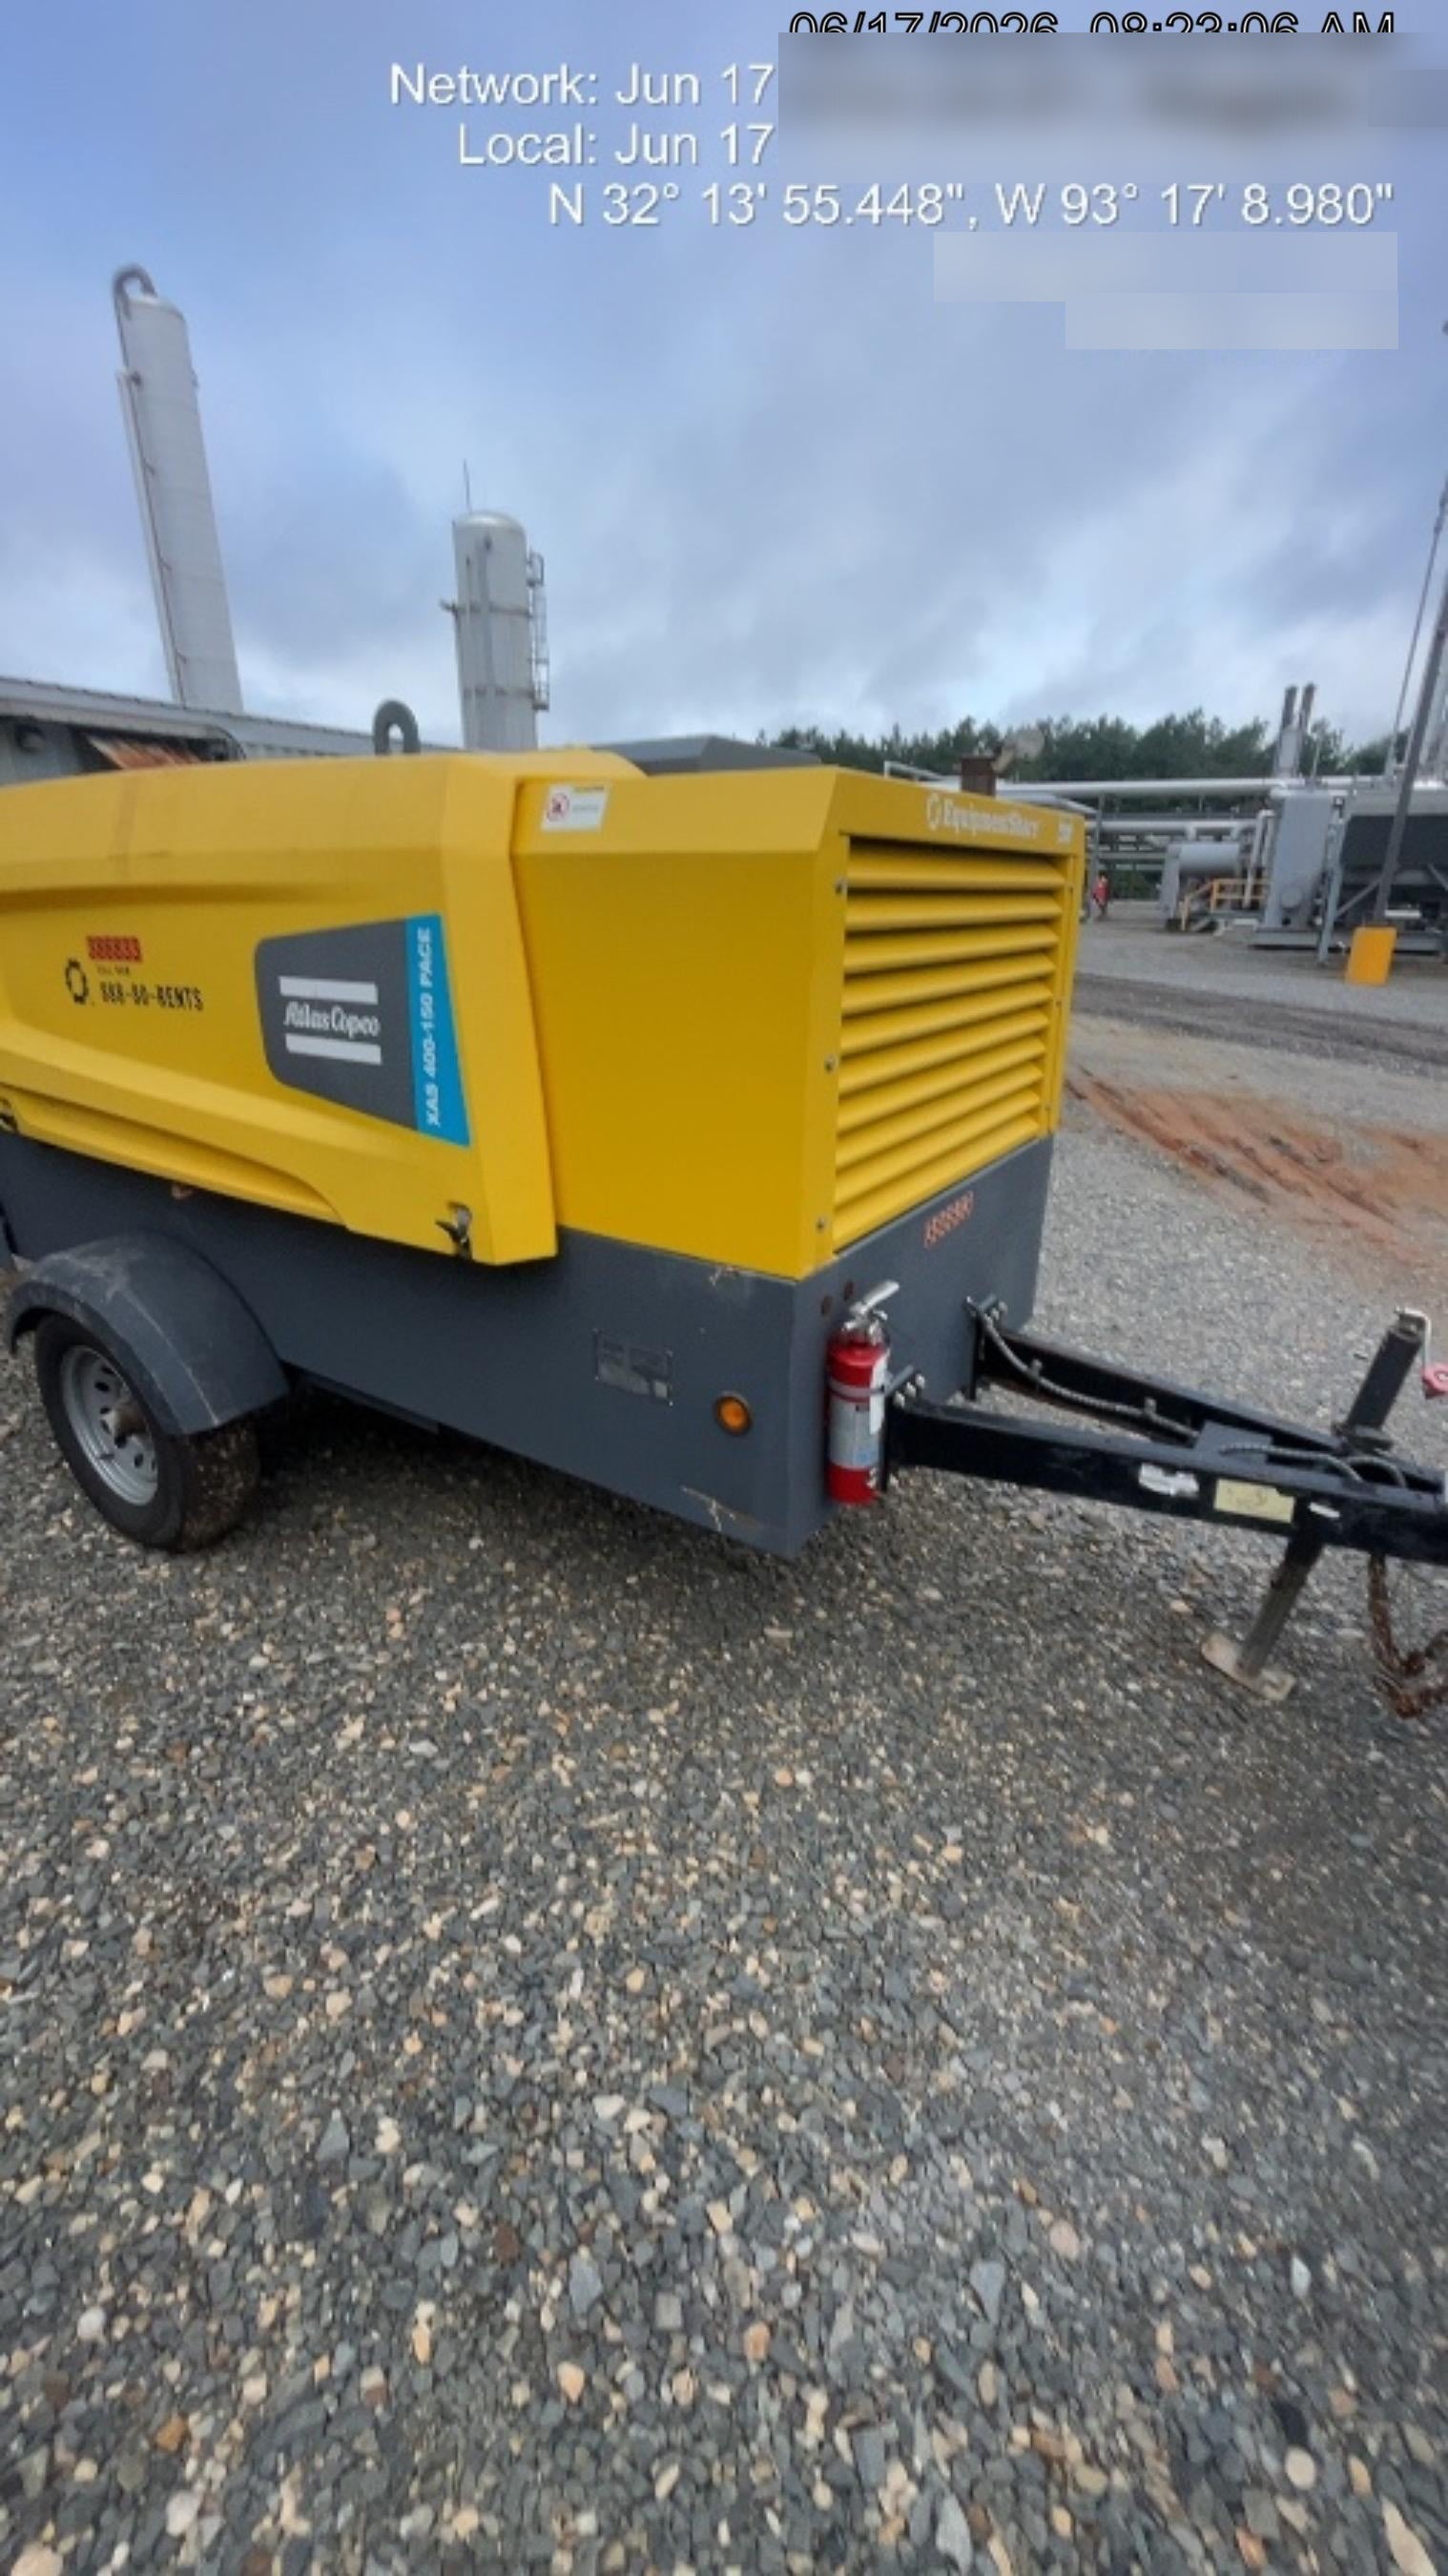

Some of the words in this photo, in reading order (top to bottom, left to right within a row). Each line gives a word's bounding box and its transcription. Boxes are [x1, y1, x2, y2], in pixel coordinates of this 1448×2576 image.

[417, 927, 434, 988] PACE
[283, 1002, 331, 1031] Atlas
[420, 993, 437, 1080] 400-150
[425, 1084, 442, 1128] XAS
